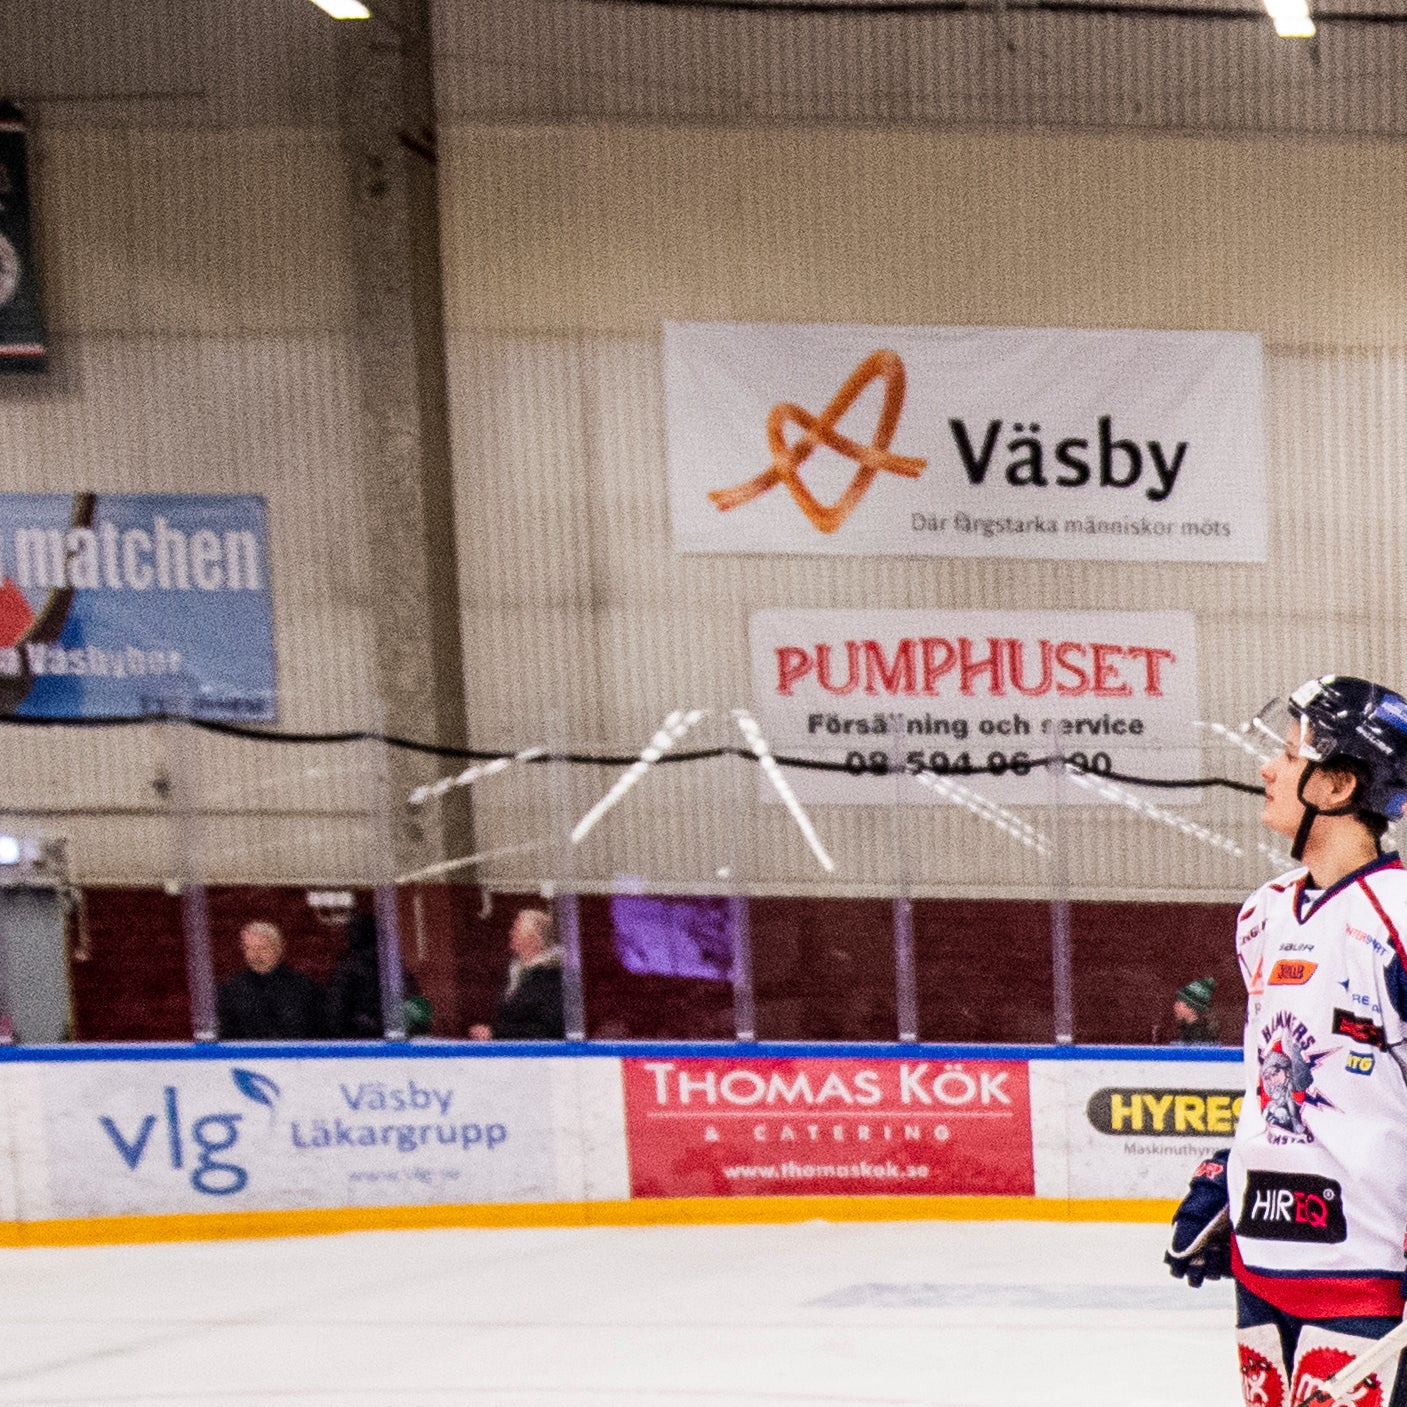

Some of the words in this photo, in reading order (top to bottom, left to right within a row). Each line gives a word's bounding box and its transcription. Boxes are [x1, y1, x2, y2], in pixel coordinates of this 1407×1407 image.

[948, 417, 1190, 502] Väsby
[15, 517, 260, 591] matchen
[773, 636, 1177, 698] PUMPHUSET
[807, 713, 970, 740] Försäning
[978, 713, 1032, 736] och
[339, 1080, 454, 1116] Väsby
[644, 1062, 882, 1106] THOMAS
[900, 1060, 1012, 1105] KÖK
[99, 1085, 250, 1196] vlg
[290, 1117, 508, 1152] Läkargrupp
[753, 1123, 951, 1142] CATERING
[1251, 1189, 1328, 1228] HIREQ
